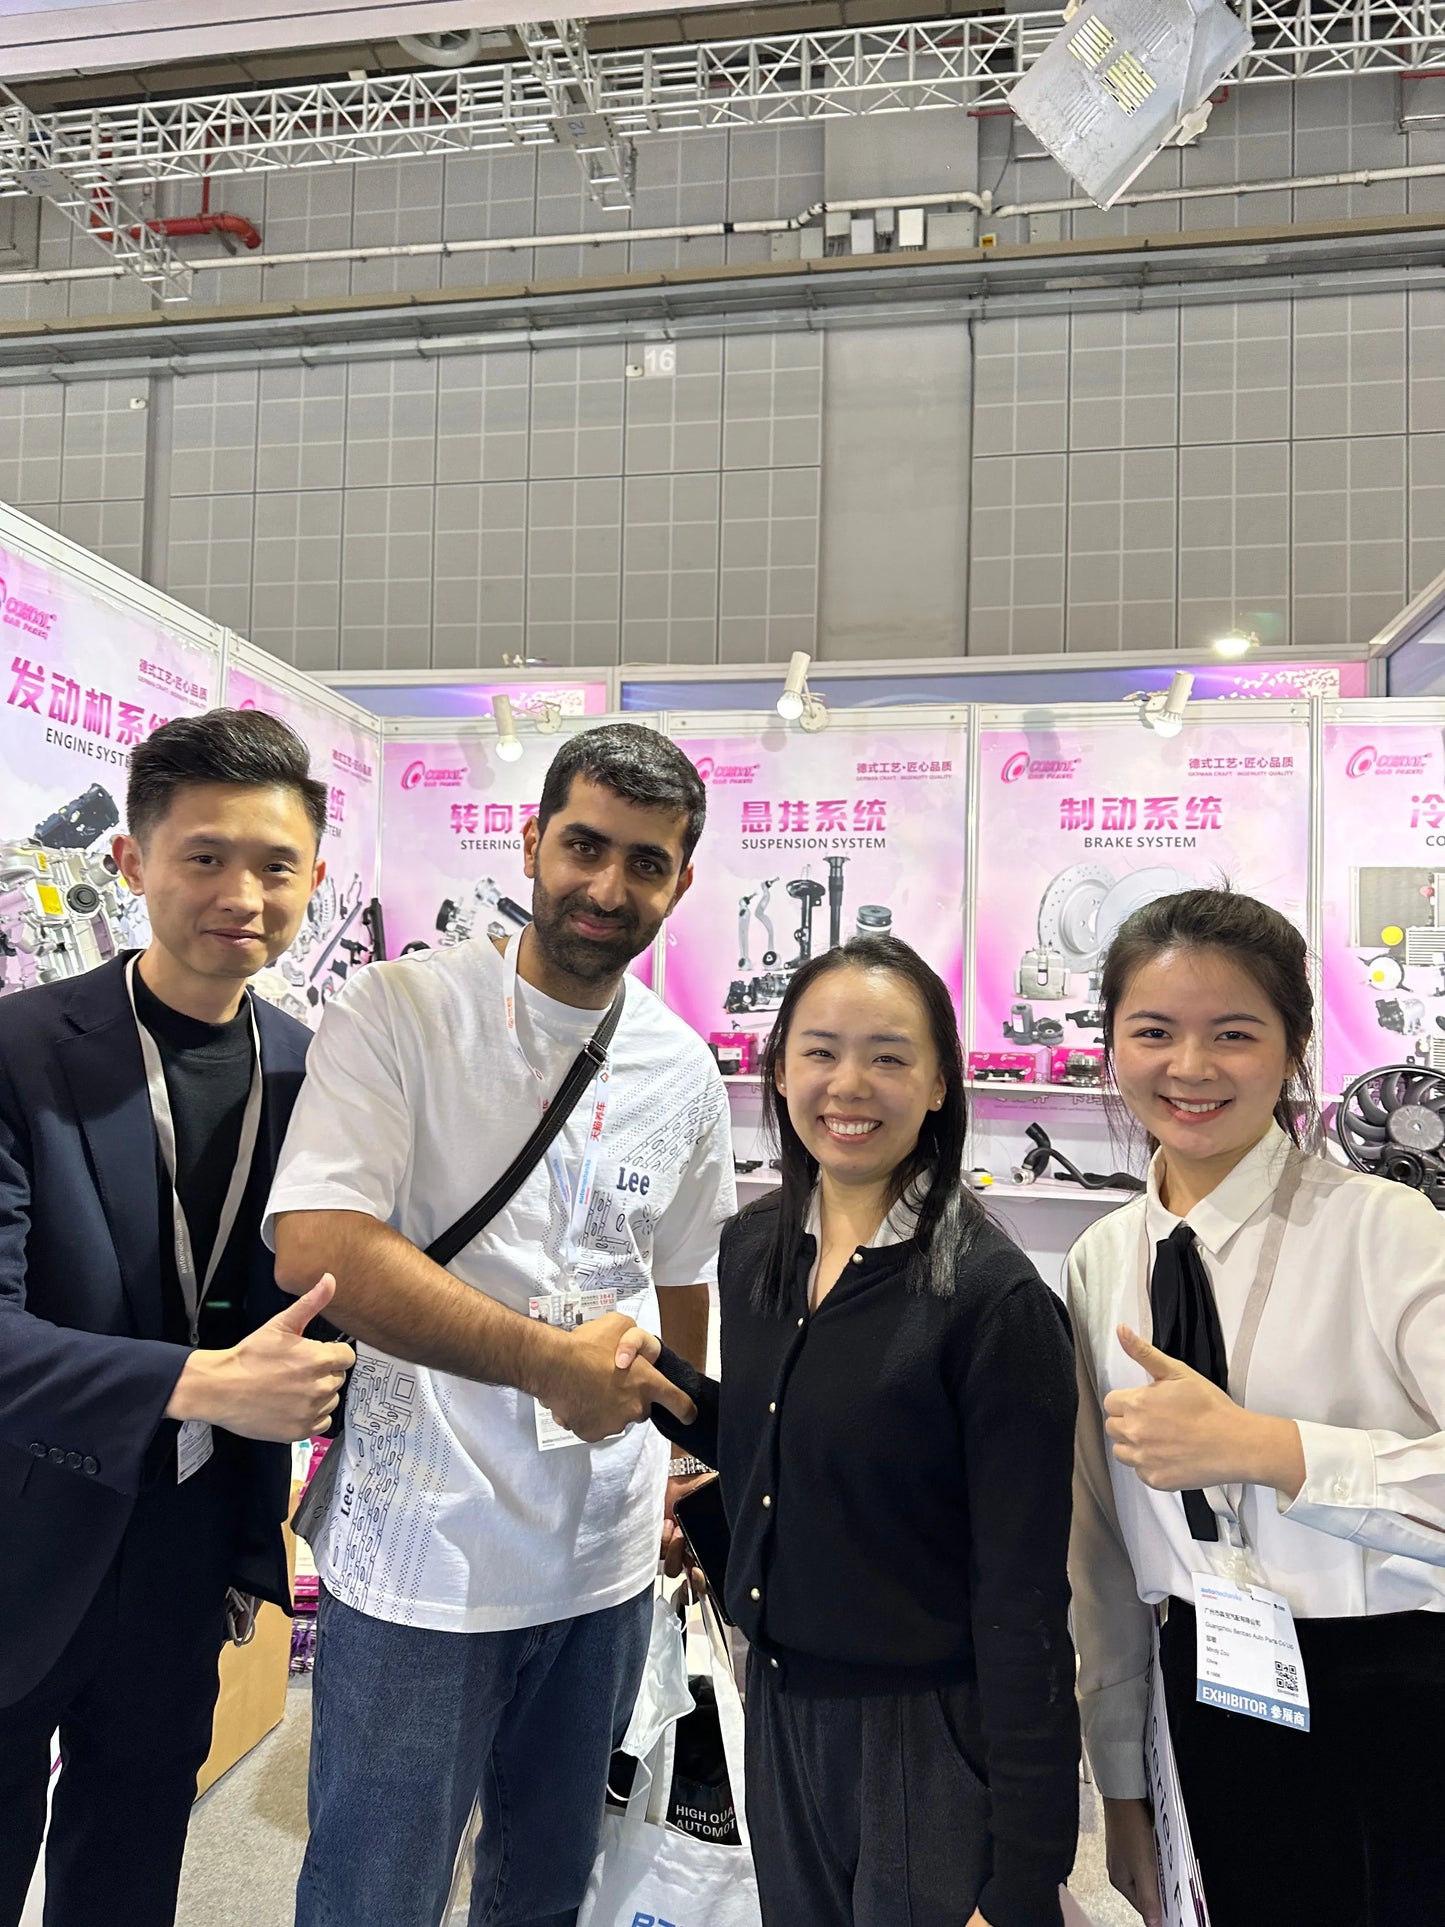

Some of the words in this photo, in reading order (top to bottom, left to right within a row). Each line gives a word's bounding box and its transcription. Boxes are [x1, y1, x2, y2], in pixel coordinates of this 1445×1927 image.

[645, 348, 675, 372] 16
[46, 727, 94, 757] ENGINE
[856, 761, 953, 774] 德式工艺·匠心品质
[1188, 756, 1294, 769] 德式工艺·匠心品质
[741, 799, 887, 833] 悬挂系统
[1060, 796, 1222, 831] 制动系统
[1410, 793, 1445, 829] 冷
[460, 839, 521, 850] STEERING
[741, 838, 828, 850] SUSPENSION
[831, 838, 886, 849] SYSTEM
[1084, 837, 1133, 848] BRAKE
[1136, 836, 1196, 848] SYSTEM
[616, 1166, 650, 1196] Lee
[340, 1482, 355, 1518] Lee
[1202, 1686, 1268, 1716] EXHIBITOR
[1270, 1704, 1305, 1727] 参展商
[676, 1804, 707, 1822] HIGH
[710, 1806, 734, 1824] QUA
[676, 1818, 735, 1838] AUTOMOT
